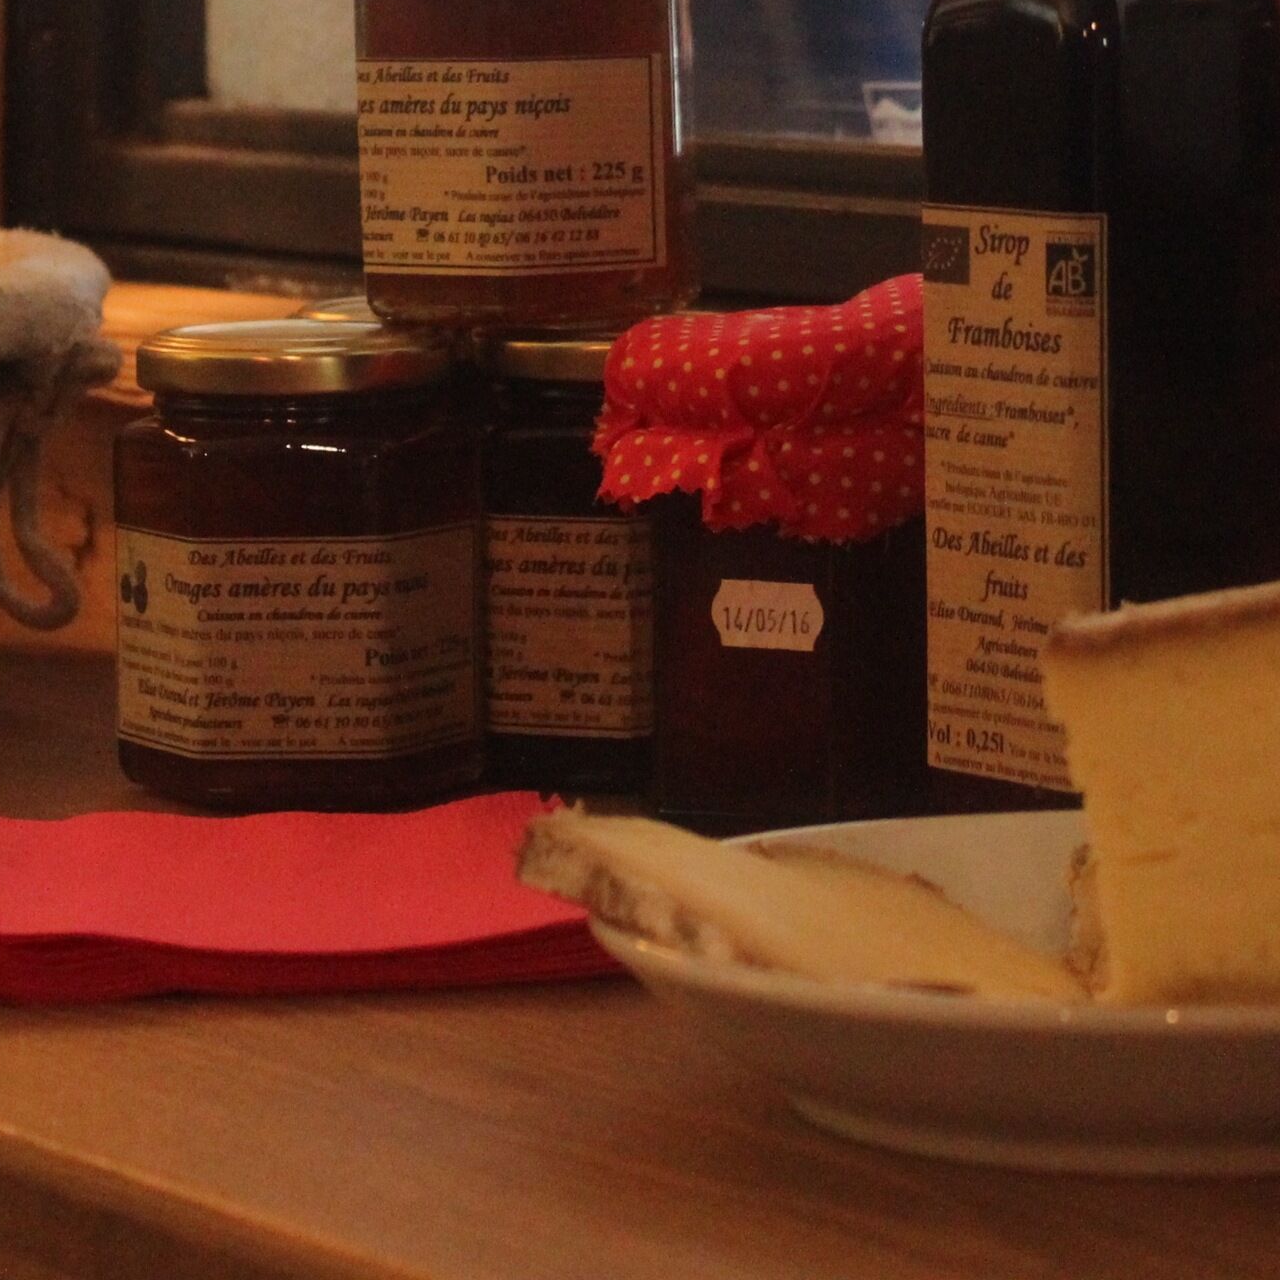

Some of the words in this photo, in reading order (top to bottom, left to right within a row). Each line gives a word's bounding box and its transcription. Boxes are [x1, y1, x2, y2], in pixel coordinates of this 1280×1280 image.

[373, 66, 423, 85] Abeilles
[426, 68, 438, 83] et
[442, 66, 462, 84] des
[466, 68, 510, 84] Fruits
[379, 94, 436, 115] amères
[440, 92, 462, 115] du
[464, 99, 508, 123] pays
[515, 93, 571, 121] niçois
[486, 165, 538, 184] Poids
[544, 164, 573, 182] net
[592, 161, 626, 181] 225
[632, 165, 644, 184] g
[365, 204, 406, 223] Jérôme
[409, 206, 449, 227] Payen
[974, 223, 1030, 266] Sirop
[991, 271, 1013, 300] de
[1048, 260, 1087, 295] AB
[948, 316, 1063, 354] Framboises
[981, 362, 1034, 385] chaudron
[1036, 367, 1051, 389] de
[956, 424, 970, 444] de
[508, 526, 571, 545] Abeilles
[576, 530, 590, 545] et
[594, 528, 619, 545] des
[932, 527, 963, 553] Des
[966, 530, 1031, 563] Abeilles
[1033, 543, 1049, 566] et
[1054, 540, 1087, 569] des
[187, 549, 218, 566] Des
[219, 547, 286, 568] Abeilles
[290, 551, 305, 565] et
[310, 547, 337, 565] des
[342, 548, 395, 565] Fruits
[519, 555, 586, 575] amères
[591, 555, 618, 576] du
[165, 572, 222, 605] Oranges
[227, 576, 301, 599] amères
[307, 574, 336, 597] du
[342, 581, 392, 604] pays
[979, 569, 1029, 603] fruits
[723, 606, 810, 635] 14/05/16
[956, 605, 1005, 631] Durand,
[203, 692, 261, 711] Jérôme
[265, 692, 316, 714] Payen
[928, 719, 951, 745] Vol
